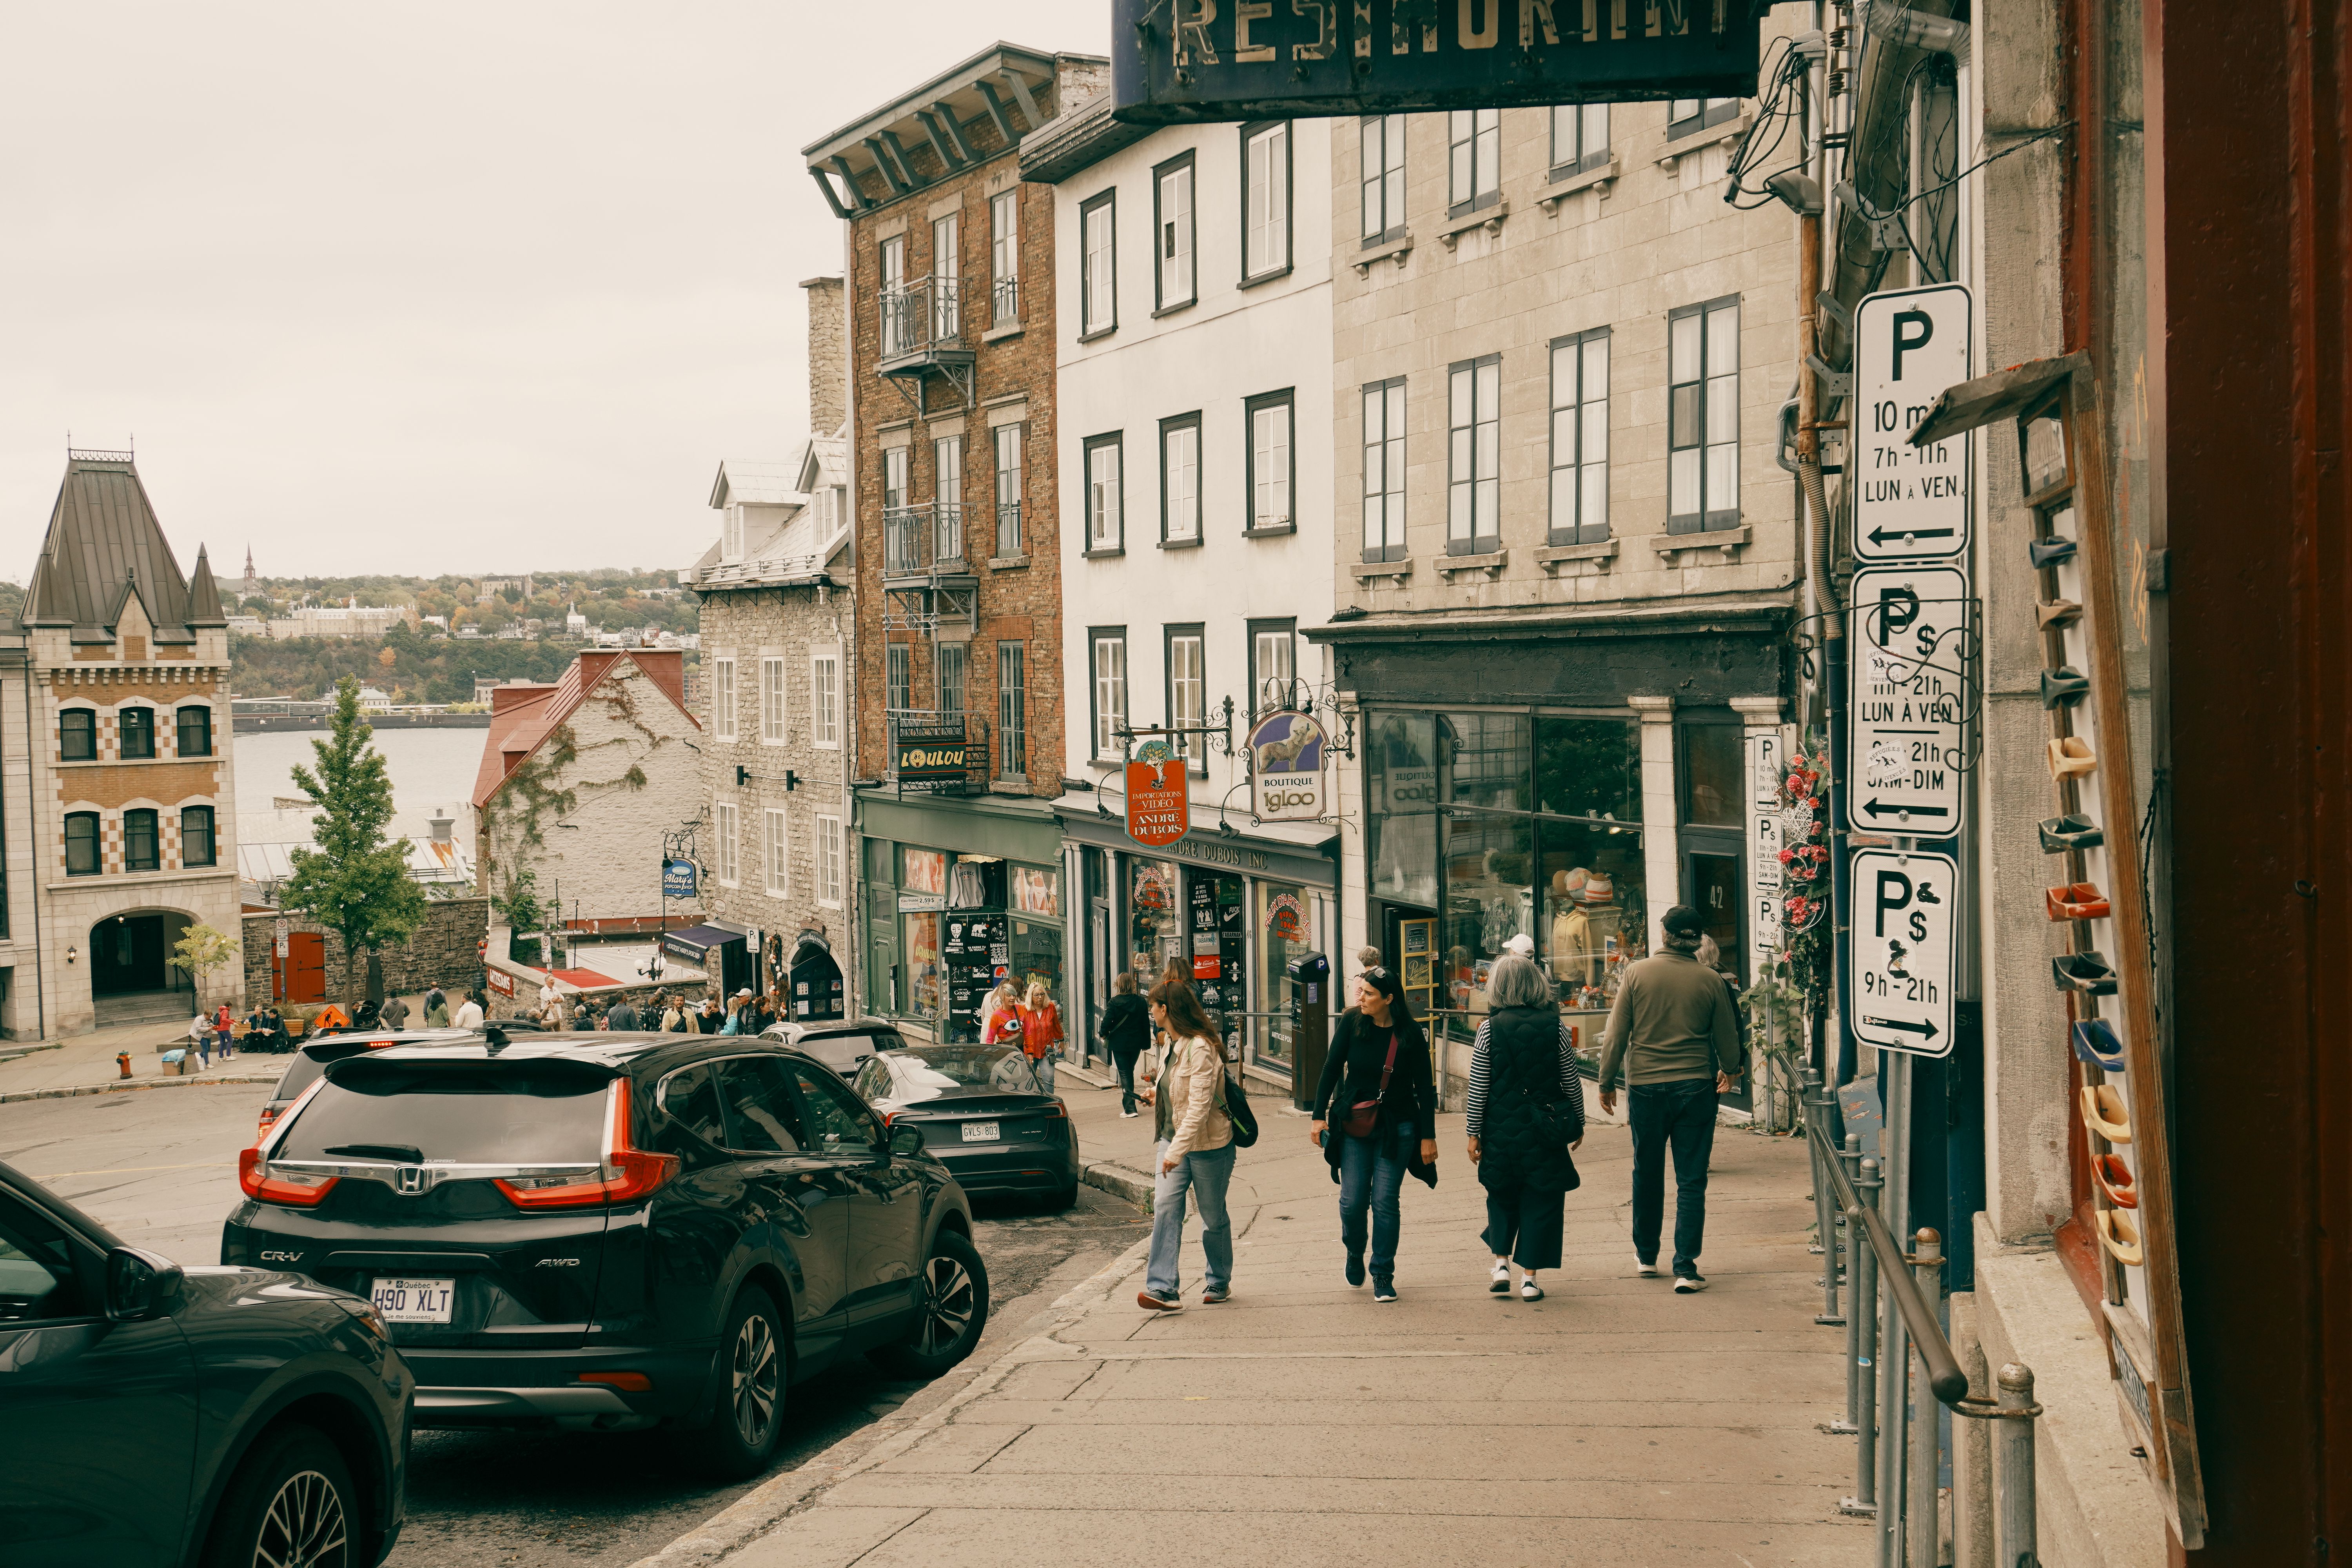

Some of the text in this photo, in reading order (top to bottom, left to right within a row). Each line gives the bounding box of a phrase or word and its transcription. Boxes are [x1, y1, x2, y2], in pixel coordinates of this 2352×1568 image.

[1892, 310, 1933, 381] P
[1874, 400, 1897, 432] 10
[1874, 446, 1897, 468] 7h
[1866, 479, 1900, 502] LUN
[1922, 475, 1957, 498] VEN
[1880, 588, 1937, 657] P $
[1913, 675, 1942, 695] 21h
[1862, 697, 1952, 724] LUN À VEN
[901, 749, 964, 768] LOULOU
[1763, 740, 1773, 760] P
[1265, 777, 1314, 787] BOUTIQUE
[1132, 791, 1181, 800] IMPORTATIONS
[1142, 798, 1173, 809] VIDÉO
[1264, 789, 1316, 811] igloo
[1136, 811, 1180, 824] ANDRÉ
[1134, 824, 1182, 836] DUBOIS
[1761, 820, 1775, 841] P $
[1204, 844, 1240, 865] DUBOIS
[664, 873, 693, 890] Mary's
[1710, 886, 1723, 909] 42
[1876, 870, 1927, 945] P $
[1264, 893, 1312, 942] FEUX D'ARTIFICES
[1762, 901, 1776, 922] P $
[750, 930, 754, 939] P
[1318, 960, 1325, 968] P
[1865, 971, 1887, 997] 9h
[1907, 977, 1937, 1004] 21h
[1272, 1031, 1285, 1041] ARTICLE
[964, 1126, 998, 1137] GVLS 803
[260, 1251, 305, 1262] CR-V
[535, 1258, 581, 1268] AWD
[403, 1281, 431, 1290] Québec
[375, 1289, 449, 1312] H90 XLT
